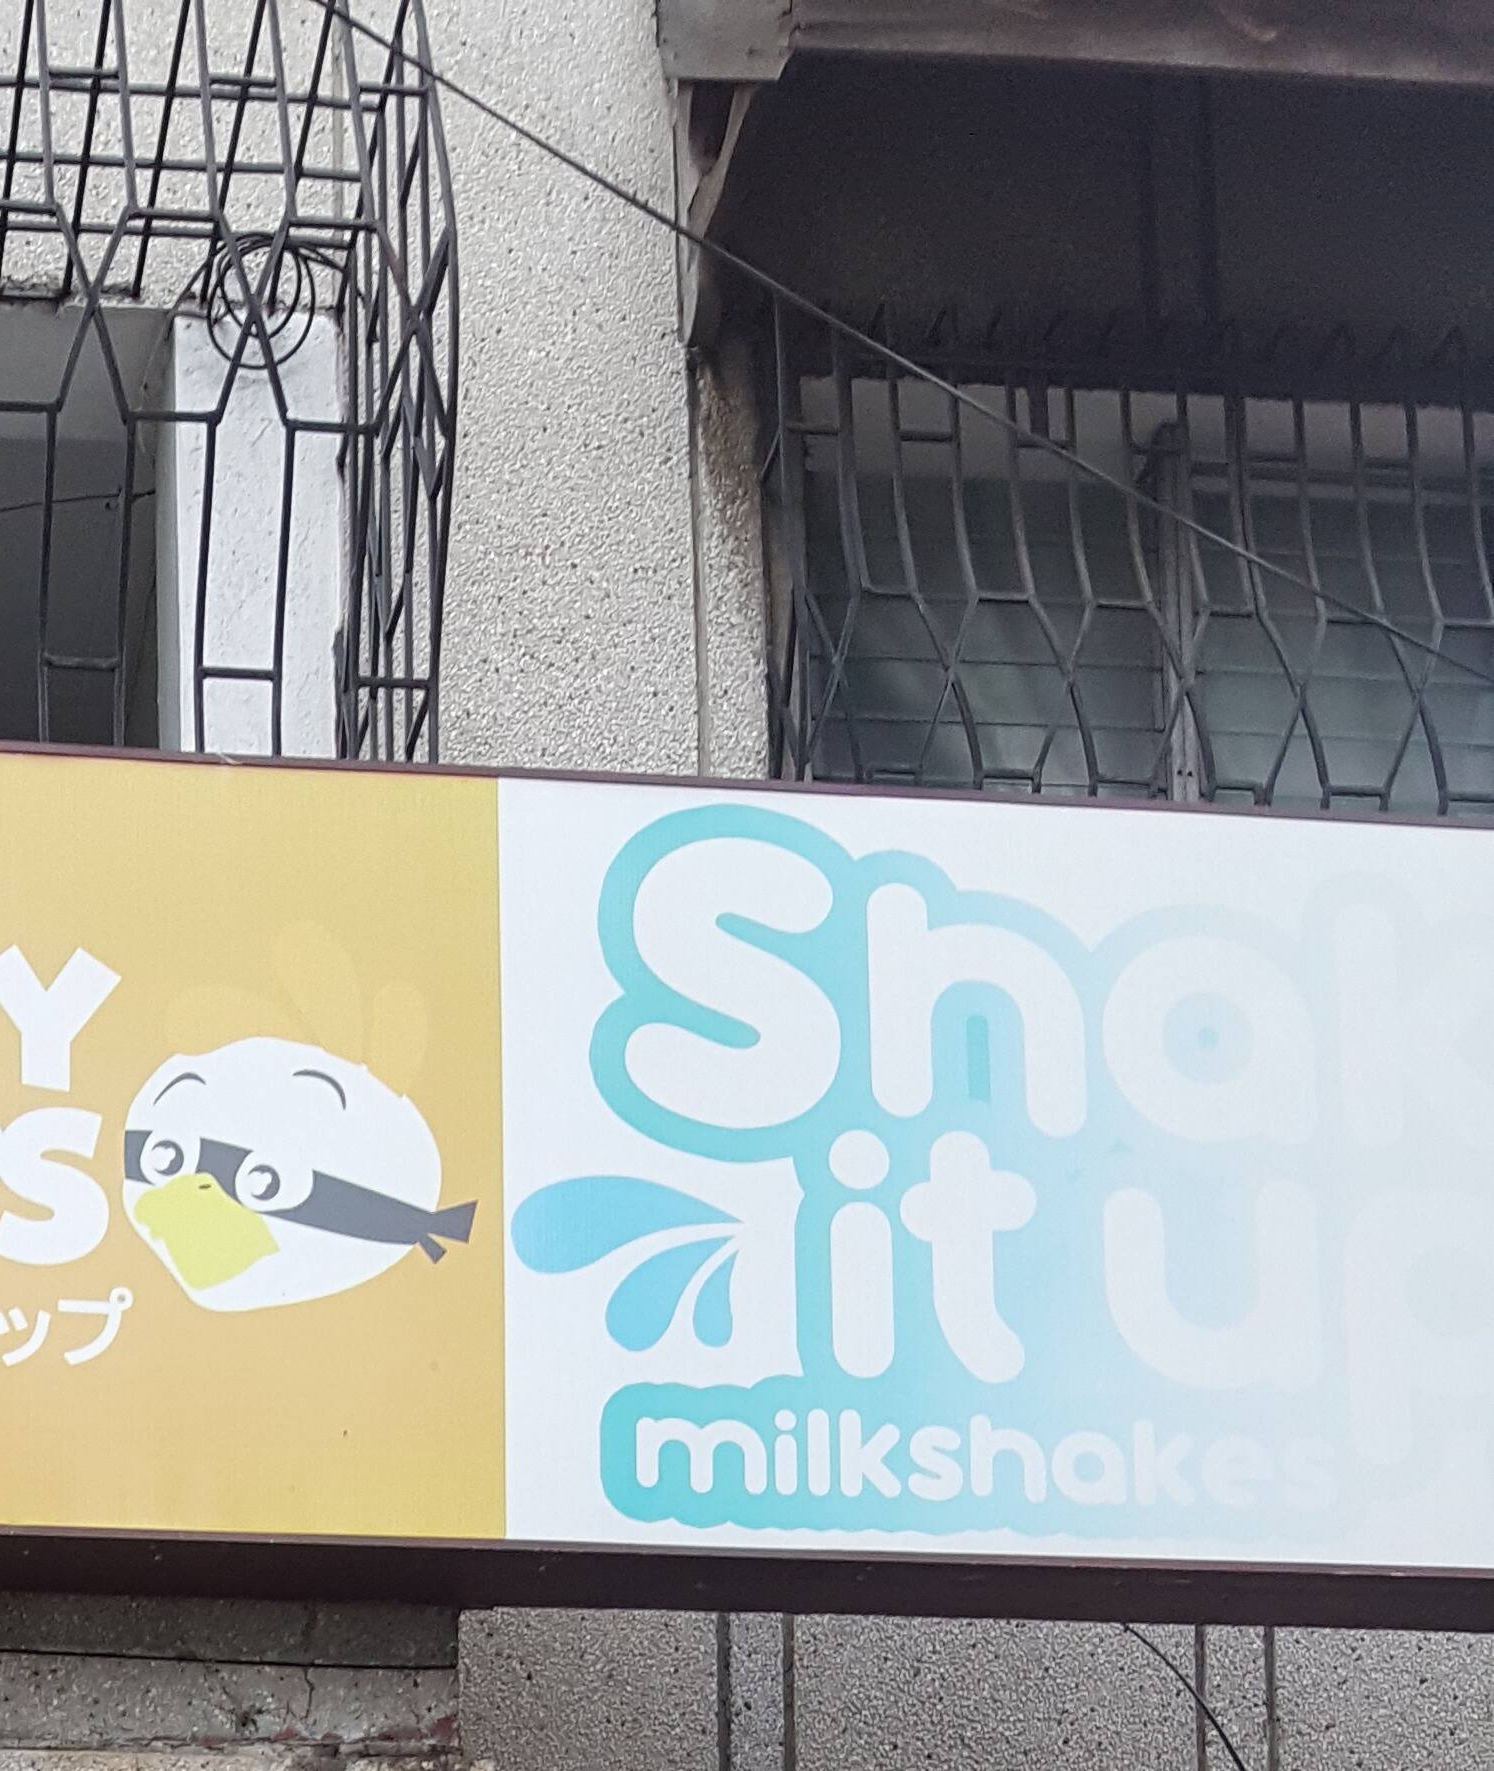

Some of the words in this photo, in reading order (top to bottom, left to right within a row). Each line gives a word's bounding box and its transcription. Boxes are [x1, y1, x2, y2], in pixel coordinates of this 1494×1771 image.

[623, 835, 1494, 1150] Shak
[828, 1128, 1038, 1384] it
[1102, 1180, 1494, 1466] up
[635, 1408, 1337, 1511] milkshakes
